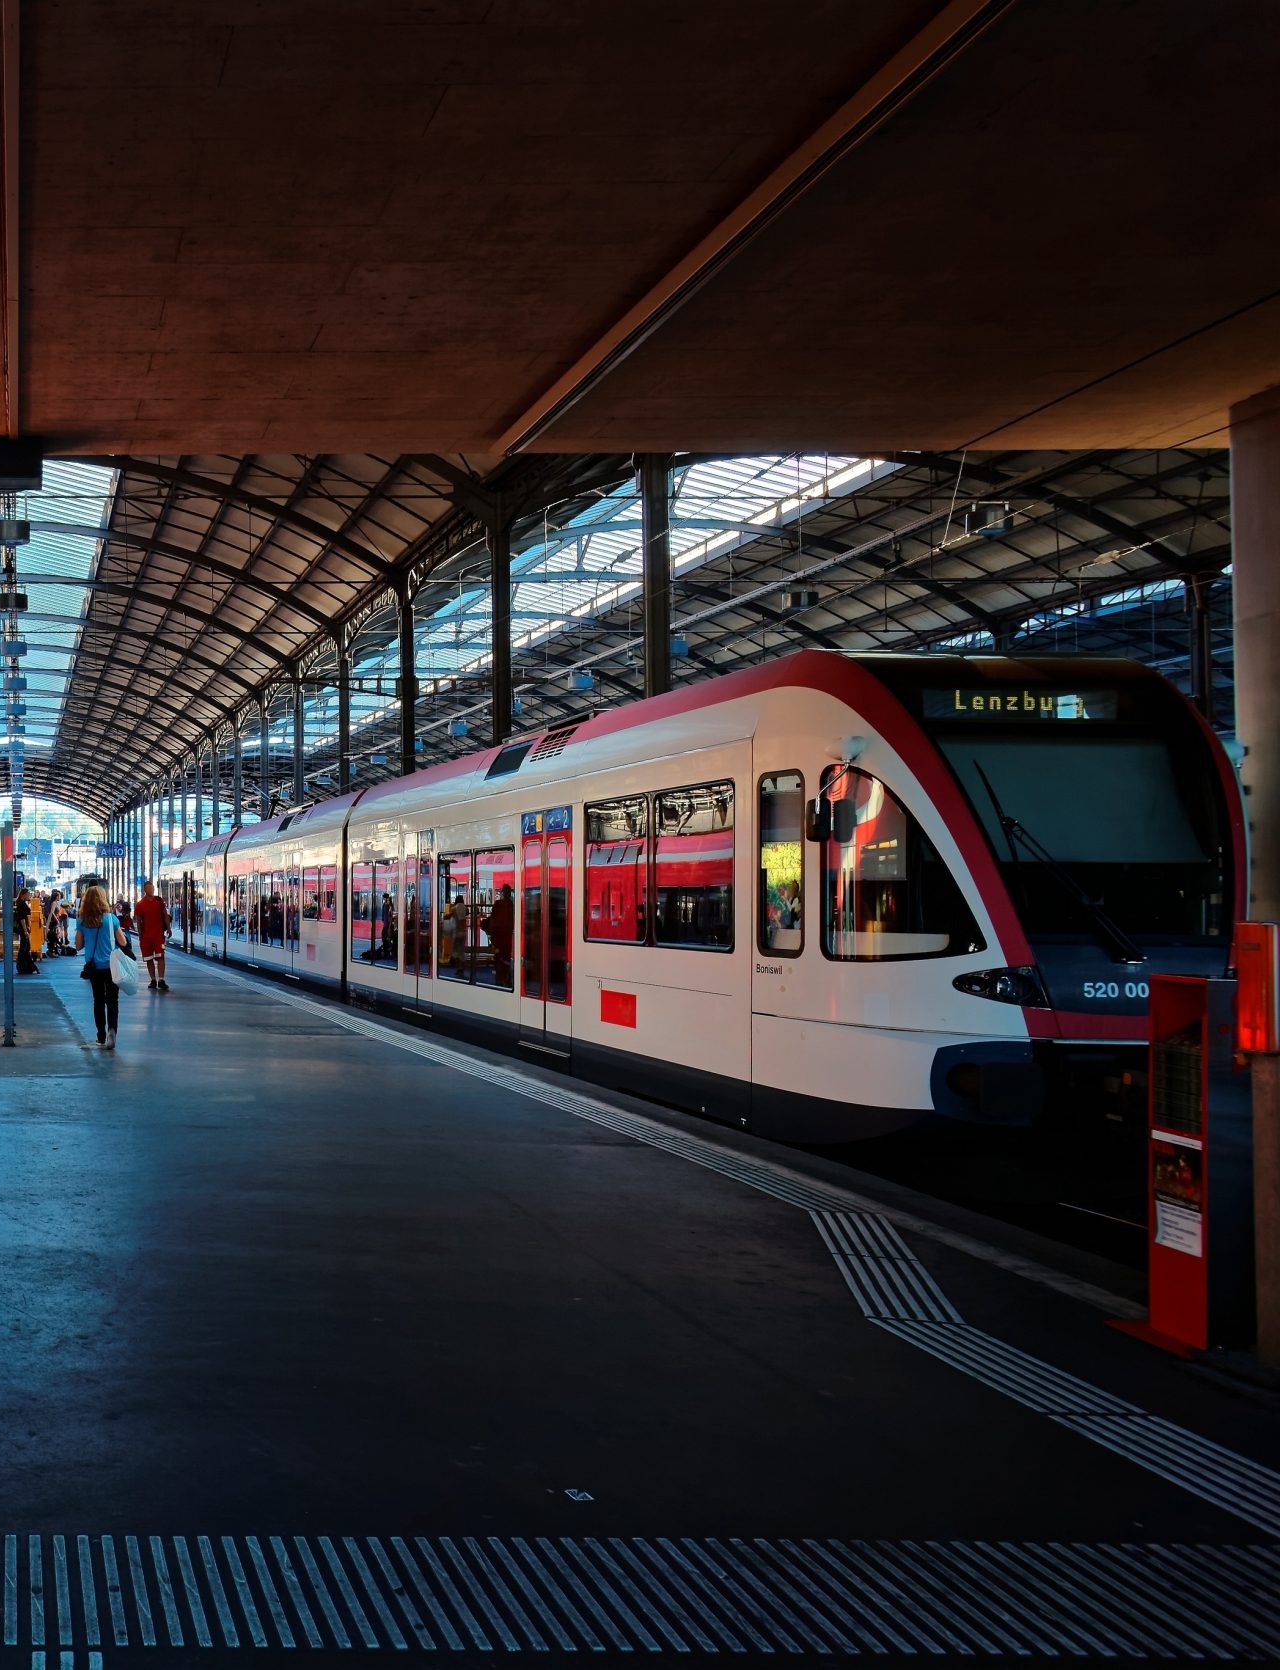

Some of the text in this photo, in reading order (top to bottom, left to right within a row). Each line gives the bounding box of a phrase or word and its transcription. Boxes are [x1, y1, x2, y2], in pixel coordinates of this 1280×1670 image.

[524, 816, 530, 834] 2
[562, 809, 568, 828] 2
[100, 848, 124, 856] A 10
[756, 963, 783, 974] Boniswil
[1083, 982, 1150, 998] 520 00
